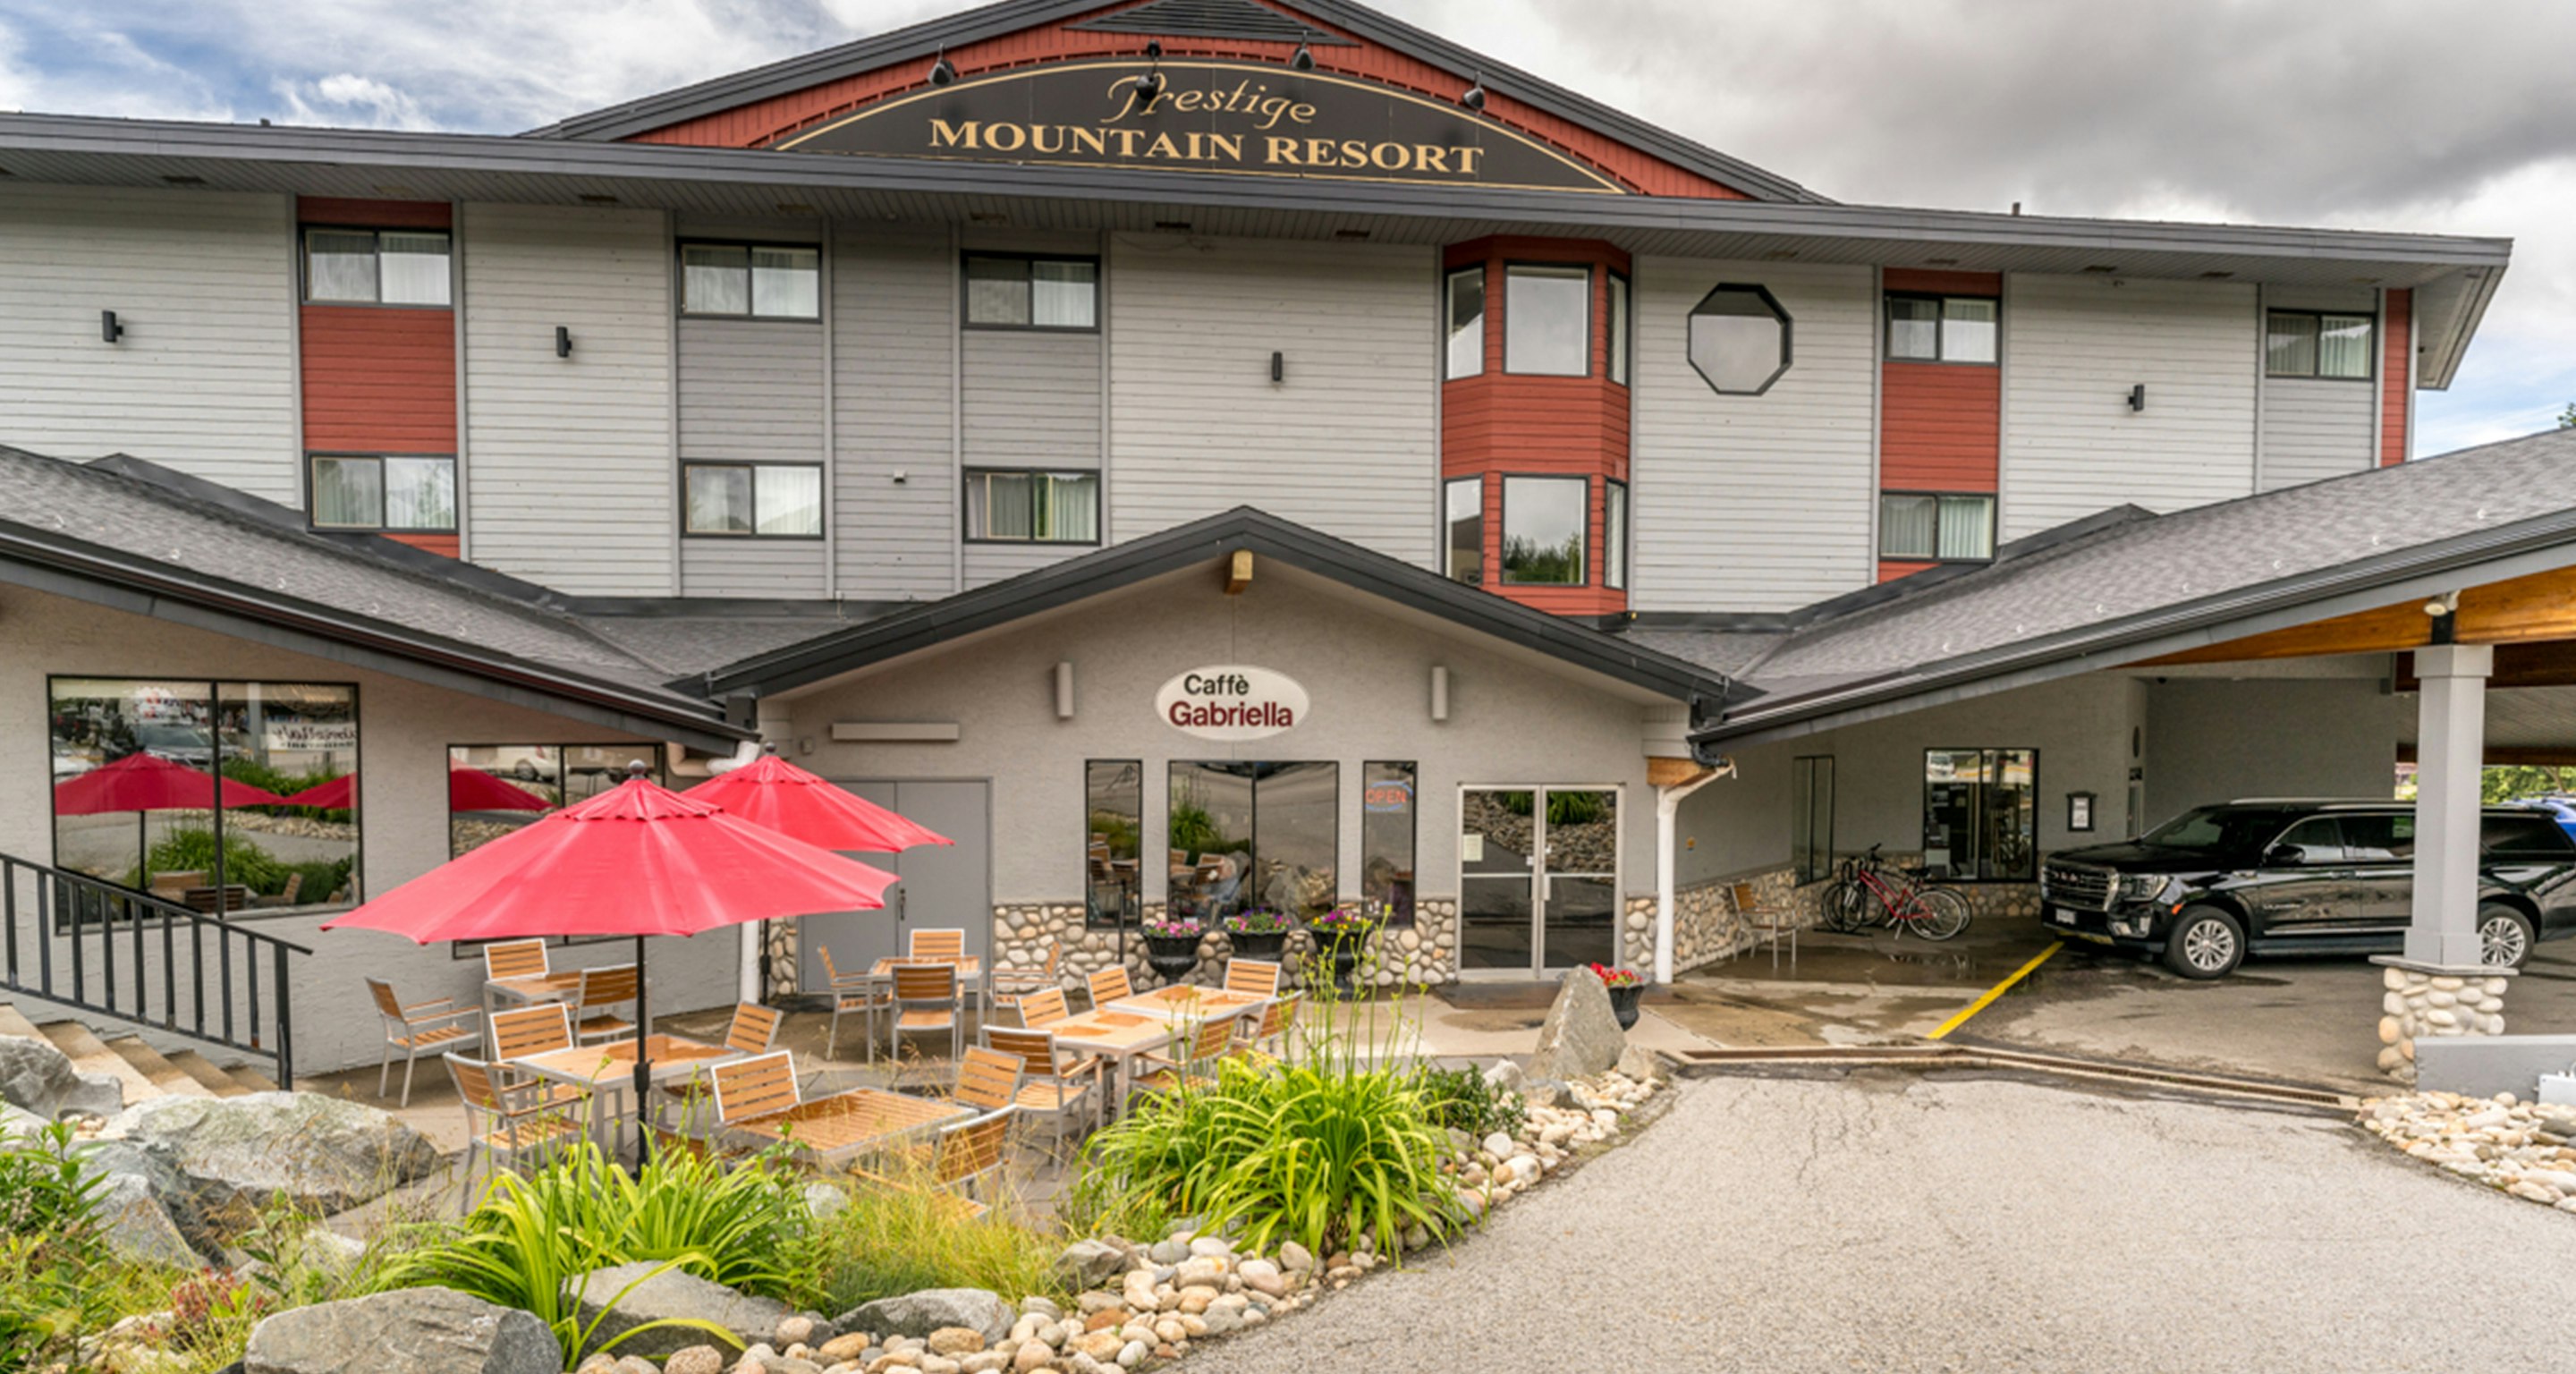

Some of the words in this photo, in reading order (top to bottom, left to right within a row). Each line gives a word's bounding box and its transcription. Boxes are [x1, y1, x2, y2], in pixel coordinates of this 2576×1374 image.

[1100, 72, 1318, 130] Prestige
[928, 118, 1244, 163] MOUNTAIN
[1263, 136, 1485, 174] RESORT
[1183, 673, 1250, 696] Caffè
[1168, 700, 1293, 727] Gabriella
[1365, 788, 1407, 803] OPEN
